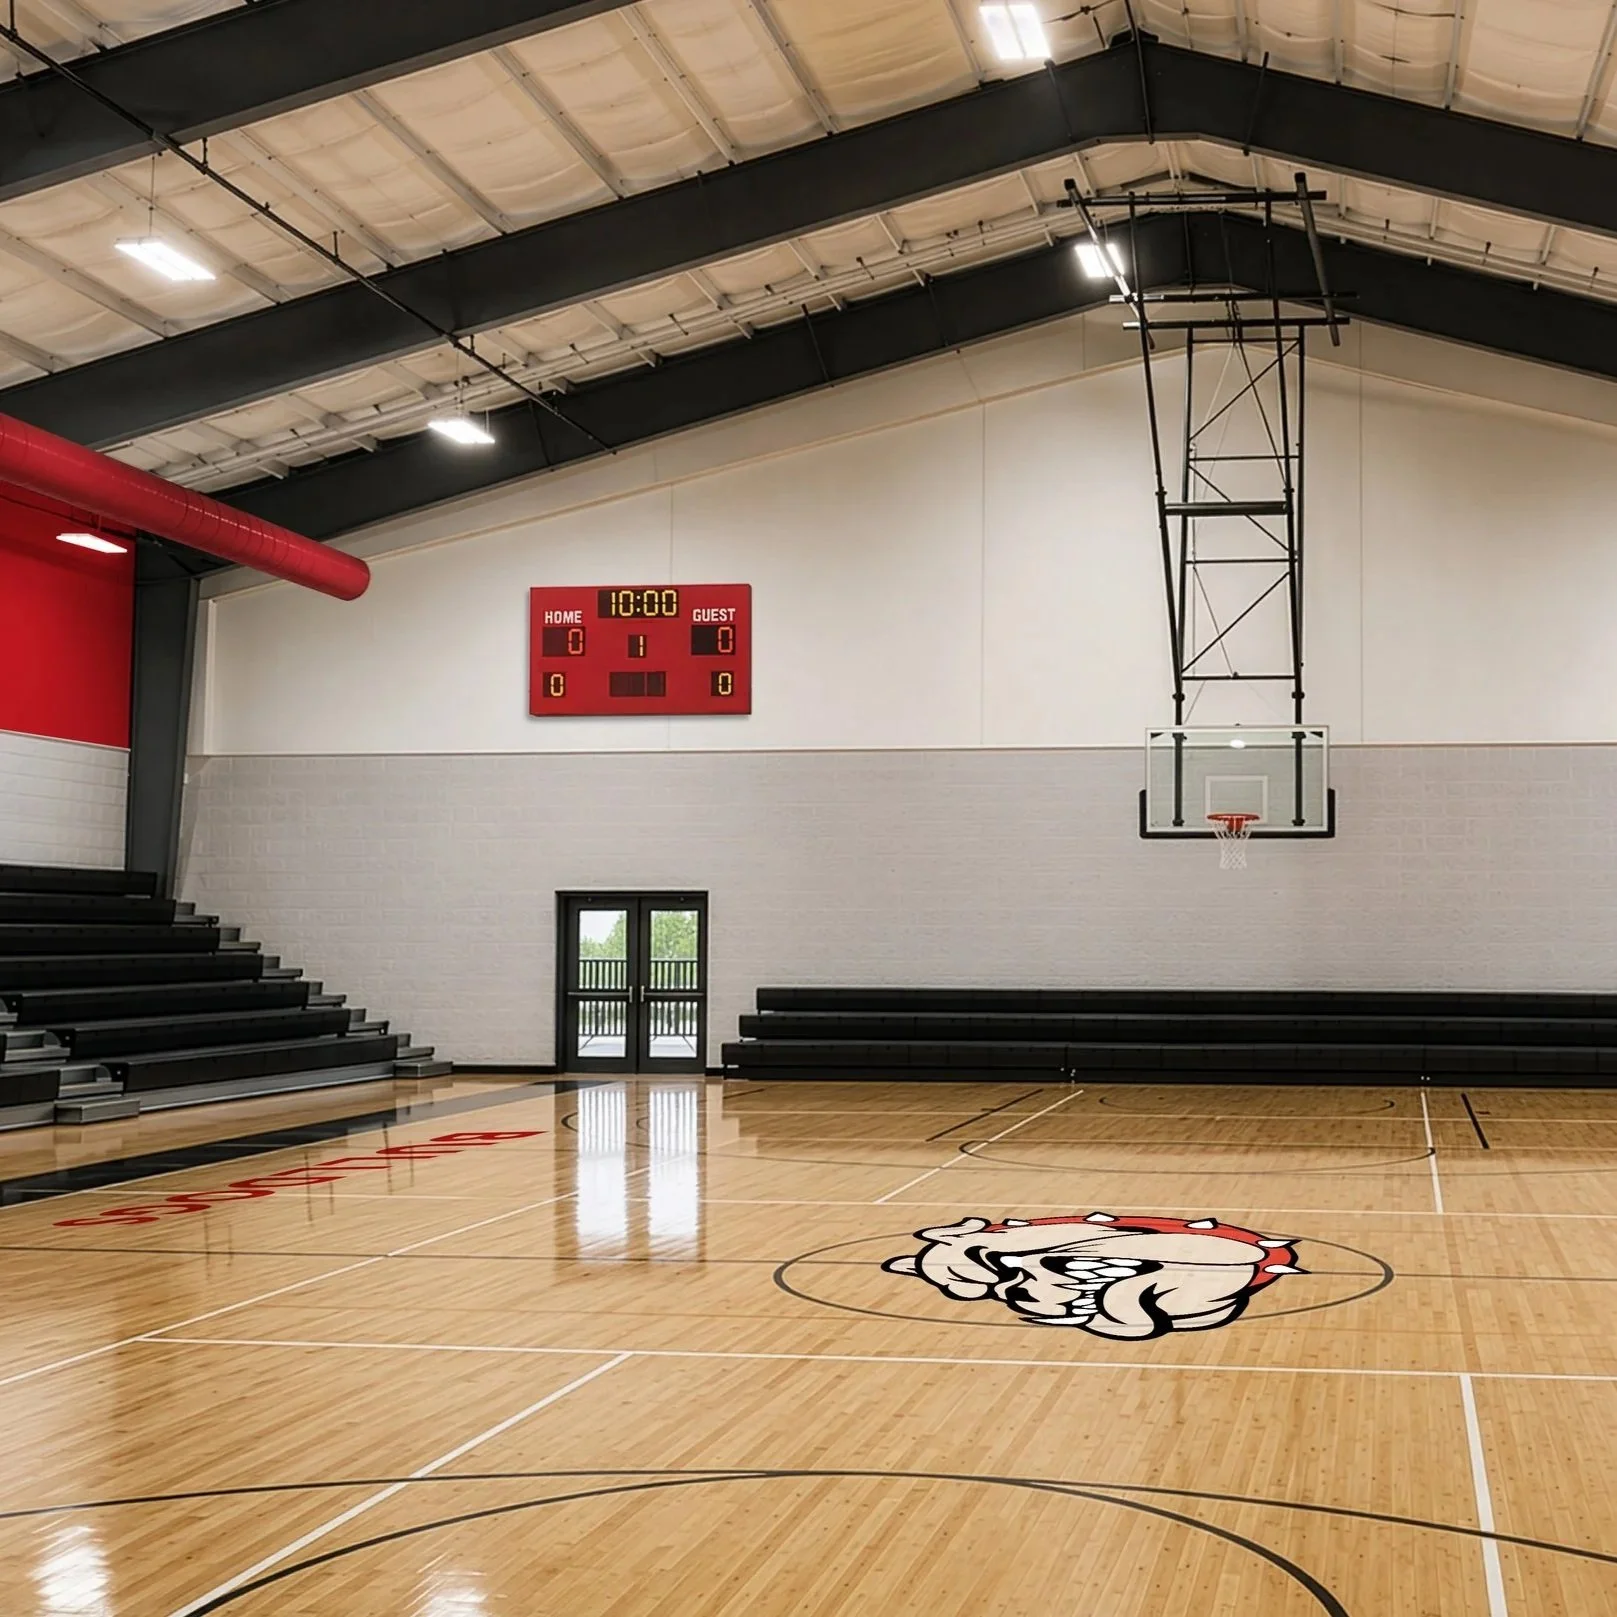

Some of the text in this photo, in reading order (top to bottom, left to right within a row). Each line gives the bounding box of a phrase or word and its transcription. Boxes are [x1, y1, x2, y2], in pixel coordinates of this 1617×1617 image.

[611, 589, 677, 617] 10:00
[544, 610, 583, 624] HOME
[692, 608, 736, 622] GUEST
[568, 629, 583, 654] 0
[639, 635, 644, 657] 1
[718, 627, 733, 653] 0
[551, 674, 564, 696] 0
[719, 673, 732, 695] 0
[53, 1131, 549, 1226] BULLDOGS
